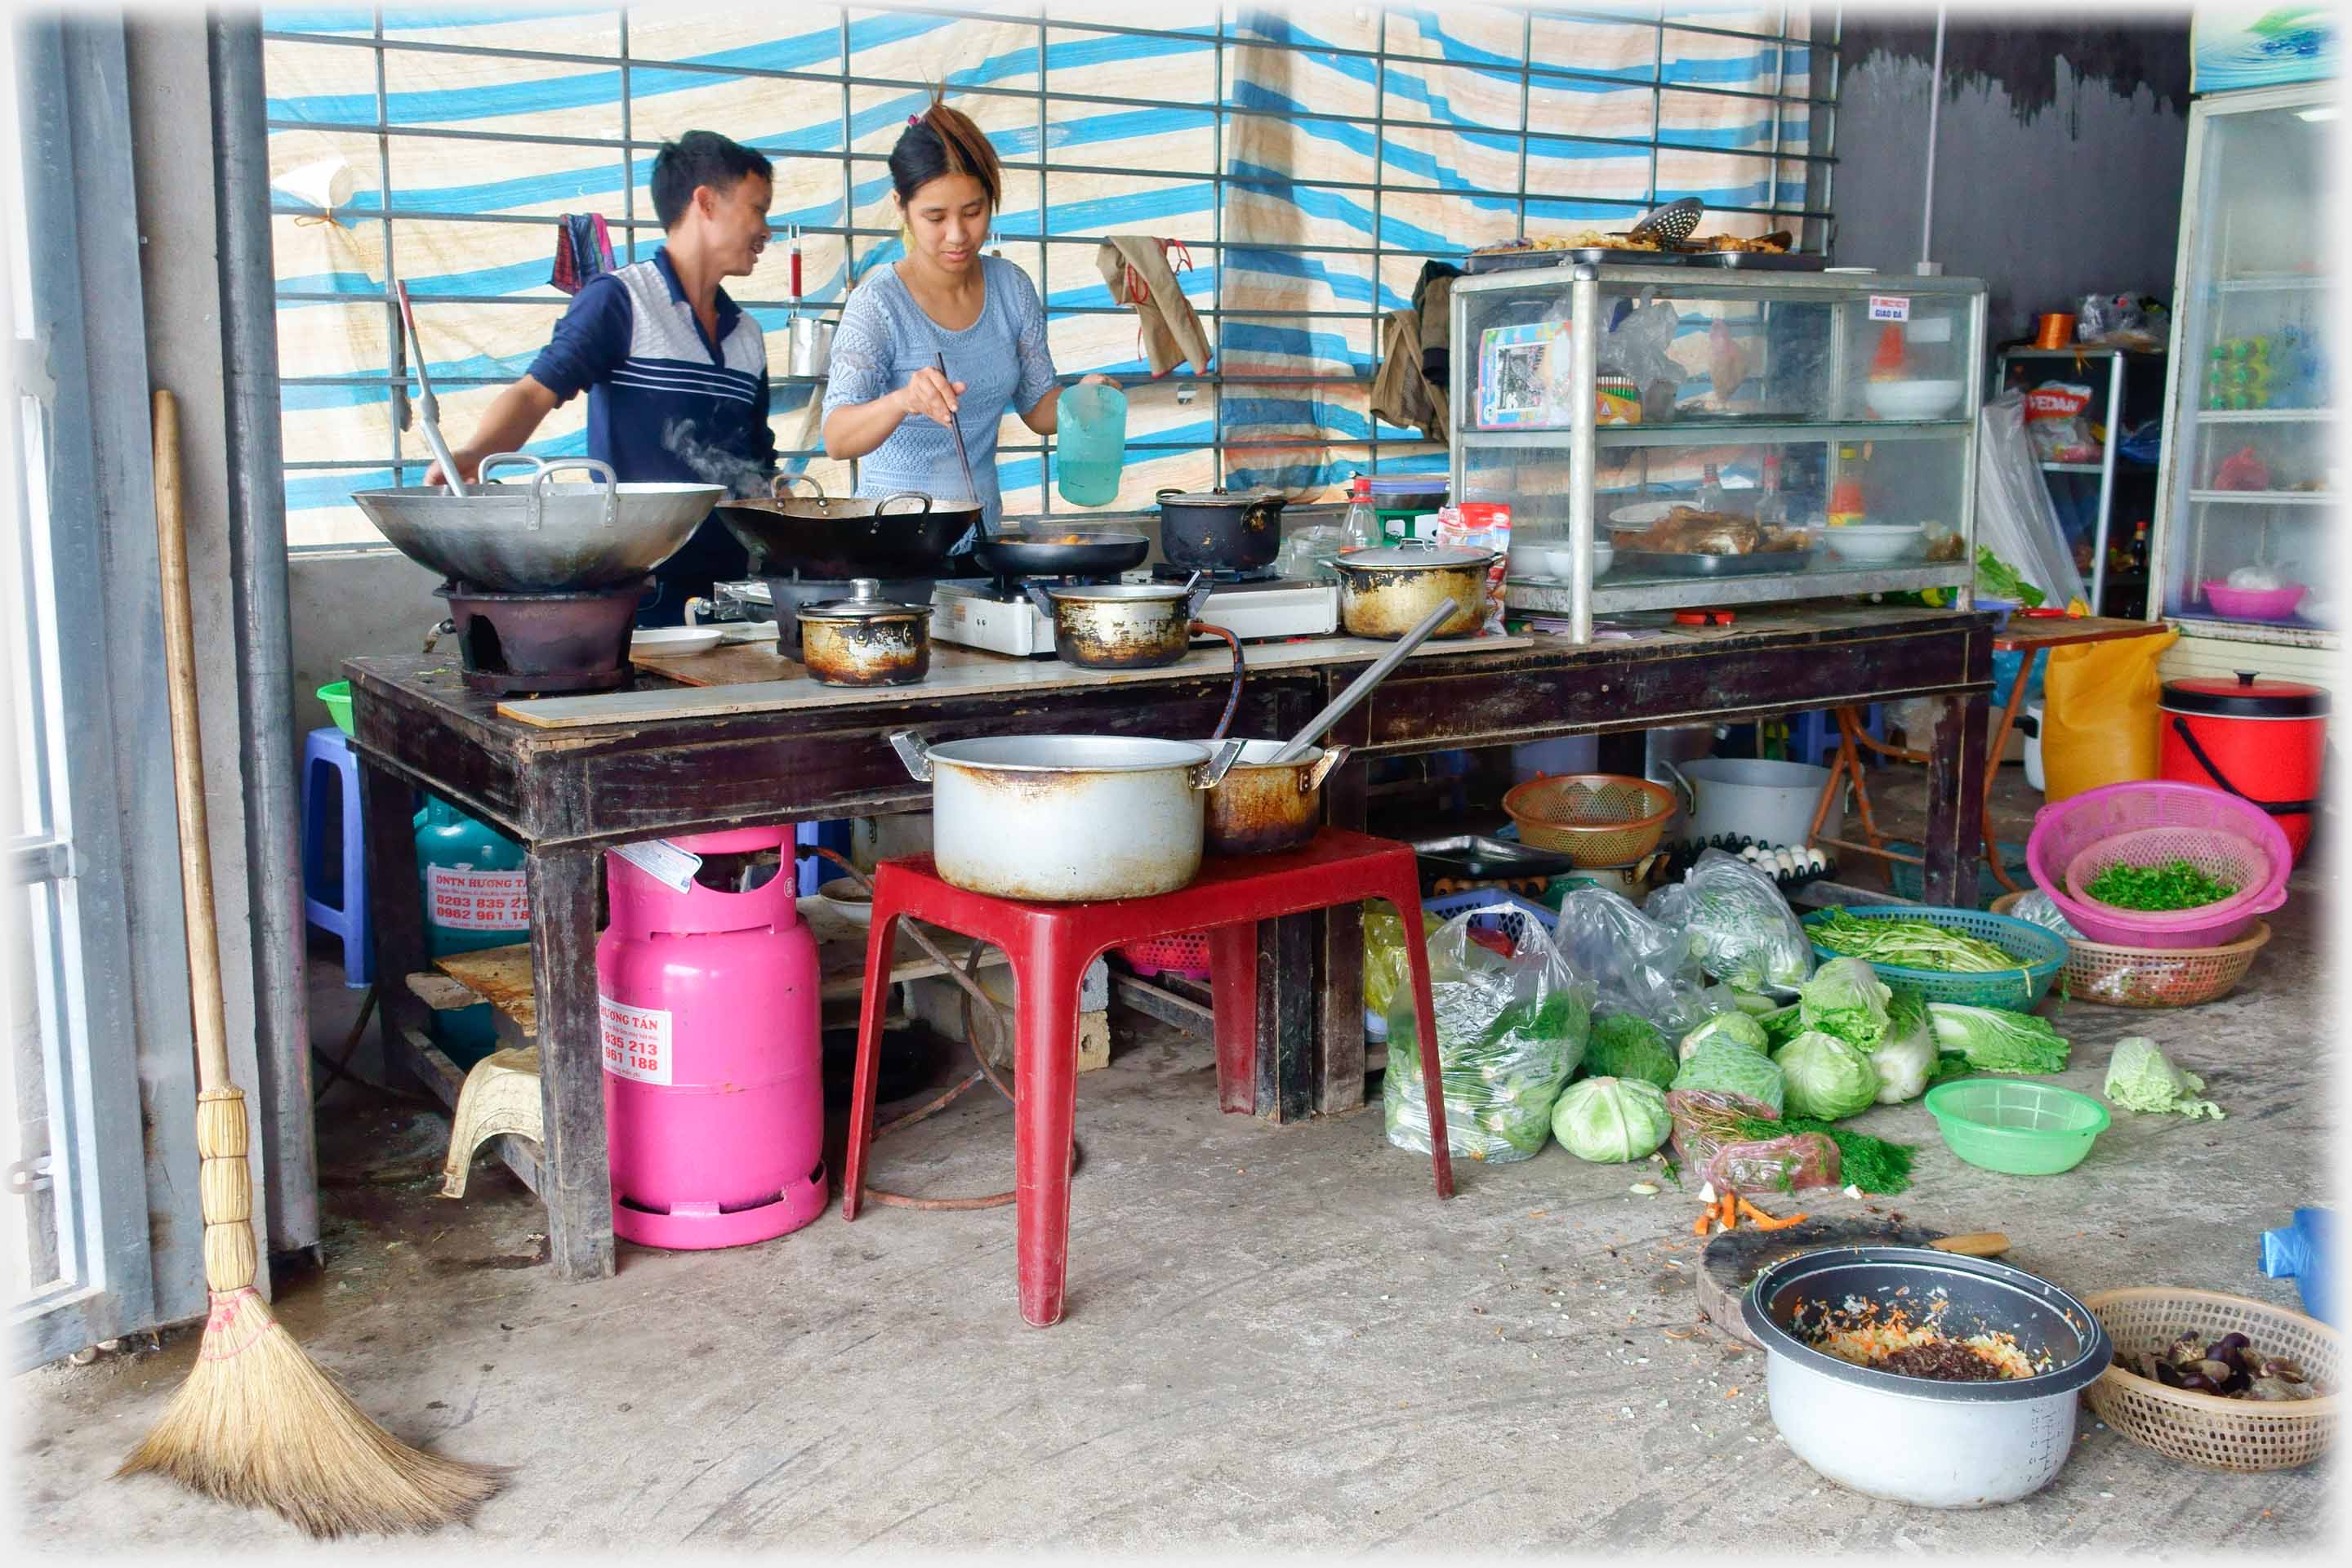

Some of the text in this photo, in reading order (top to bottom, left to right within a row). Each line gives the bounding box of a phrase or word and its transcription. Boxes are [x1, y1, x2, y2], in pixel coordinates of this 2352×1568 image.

[436, 875, 465, 886] DNTN
[476, 898, 505, 908] 835
[476, 911, 503, 920] 961
[629, 1040, 657, 1056] 213
[629, 1056, 657, 1071] 188
